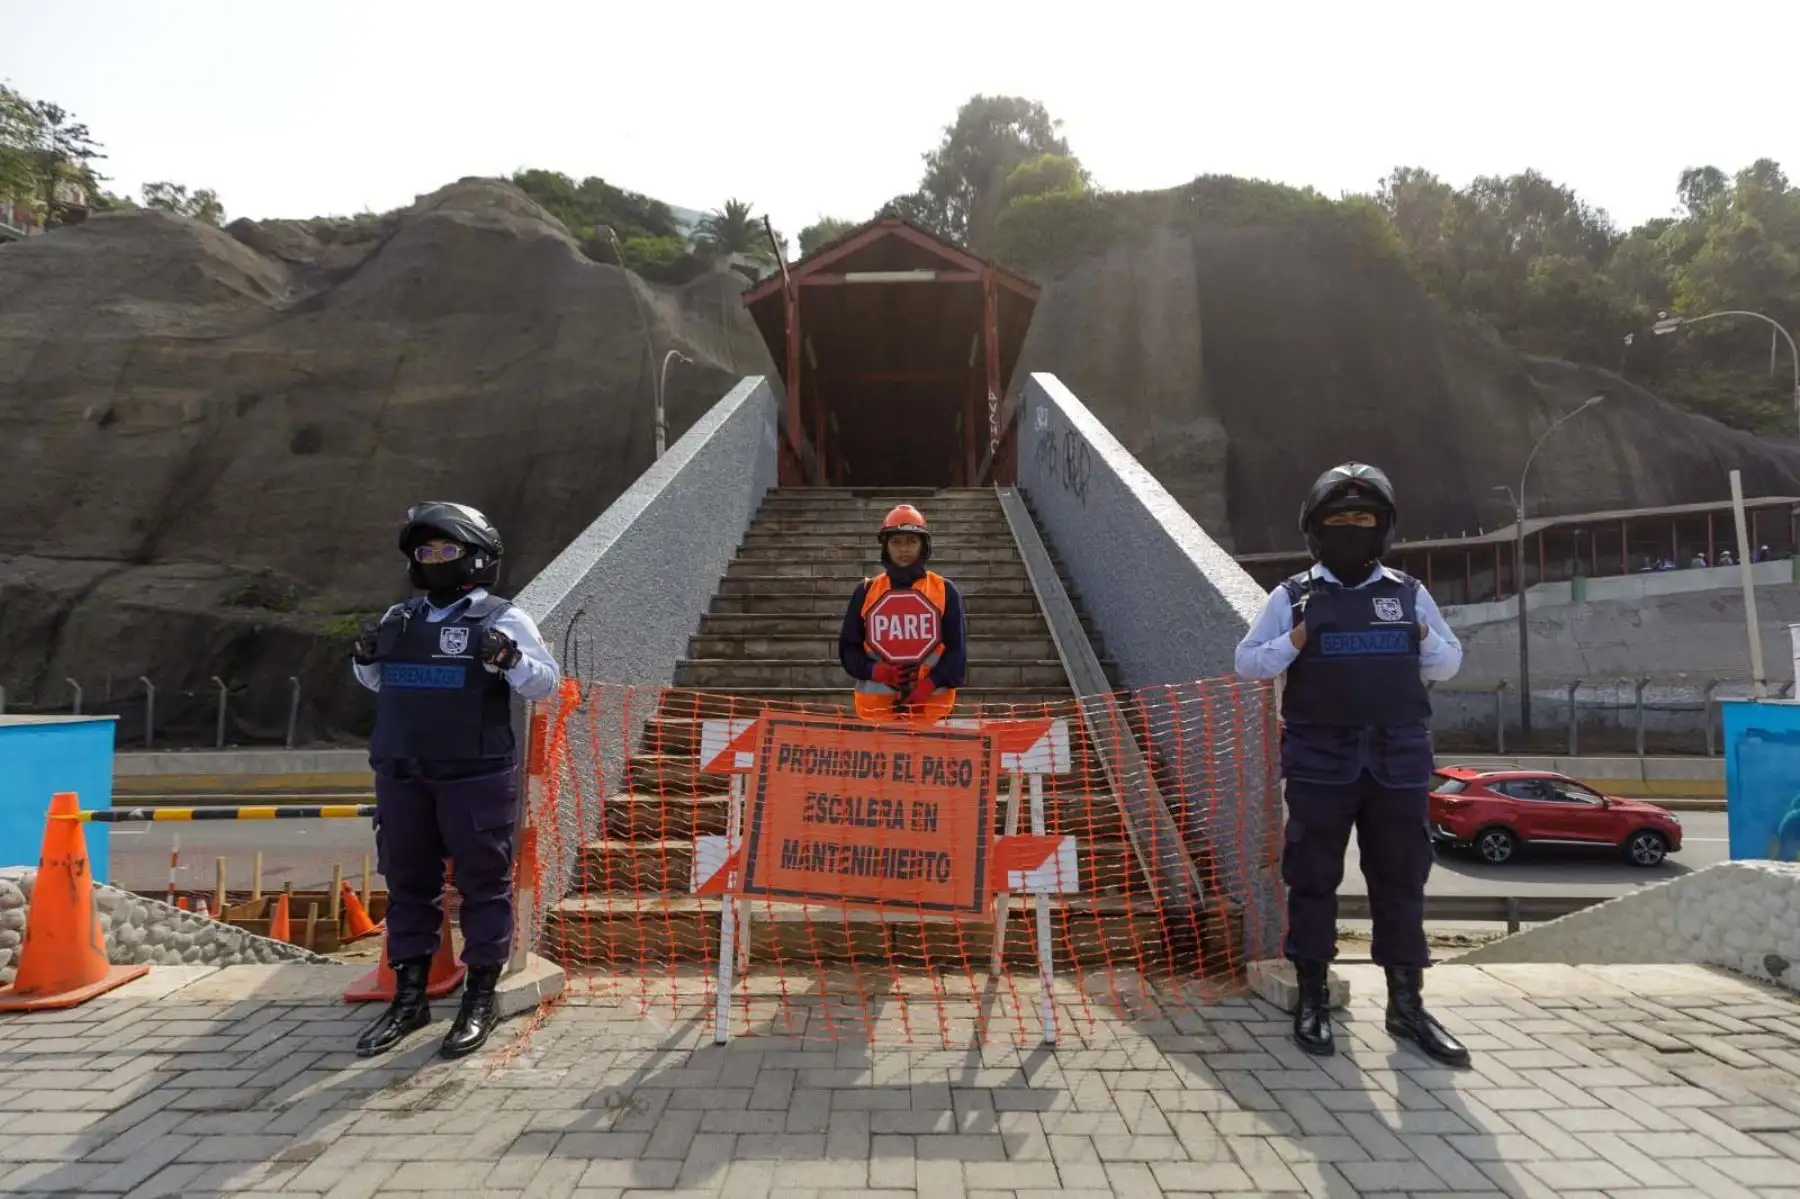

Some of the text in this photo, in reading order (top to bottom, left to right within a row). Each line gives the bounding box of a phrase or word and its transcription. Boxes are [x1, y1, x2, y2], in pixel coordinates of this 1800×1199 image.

[874, 613, 932, 641] PARE
[892, 752, 915, 783] EL
[921, 756, 973, 788] PASO
[803, 791, 938, 832] ESCALERA EN
[780, 838, 951, 883] MANTENIMIENTO
